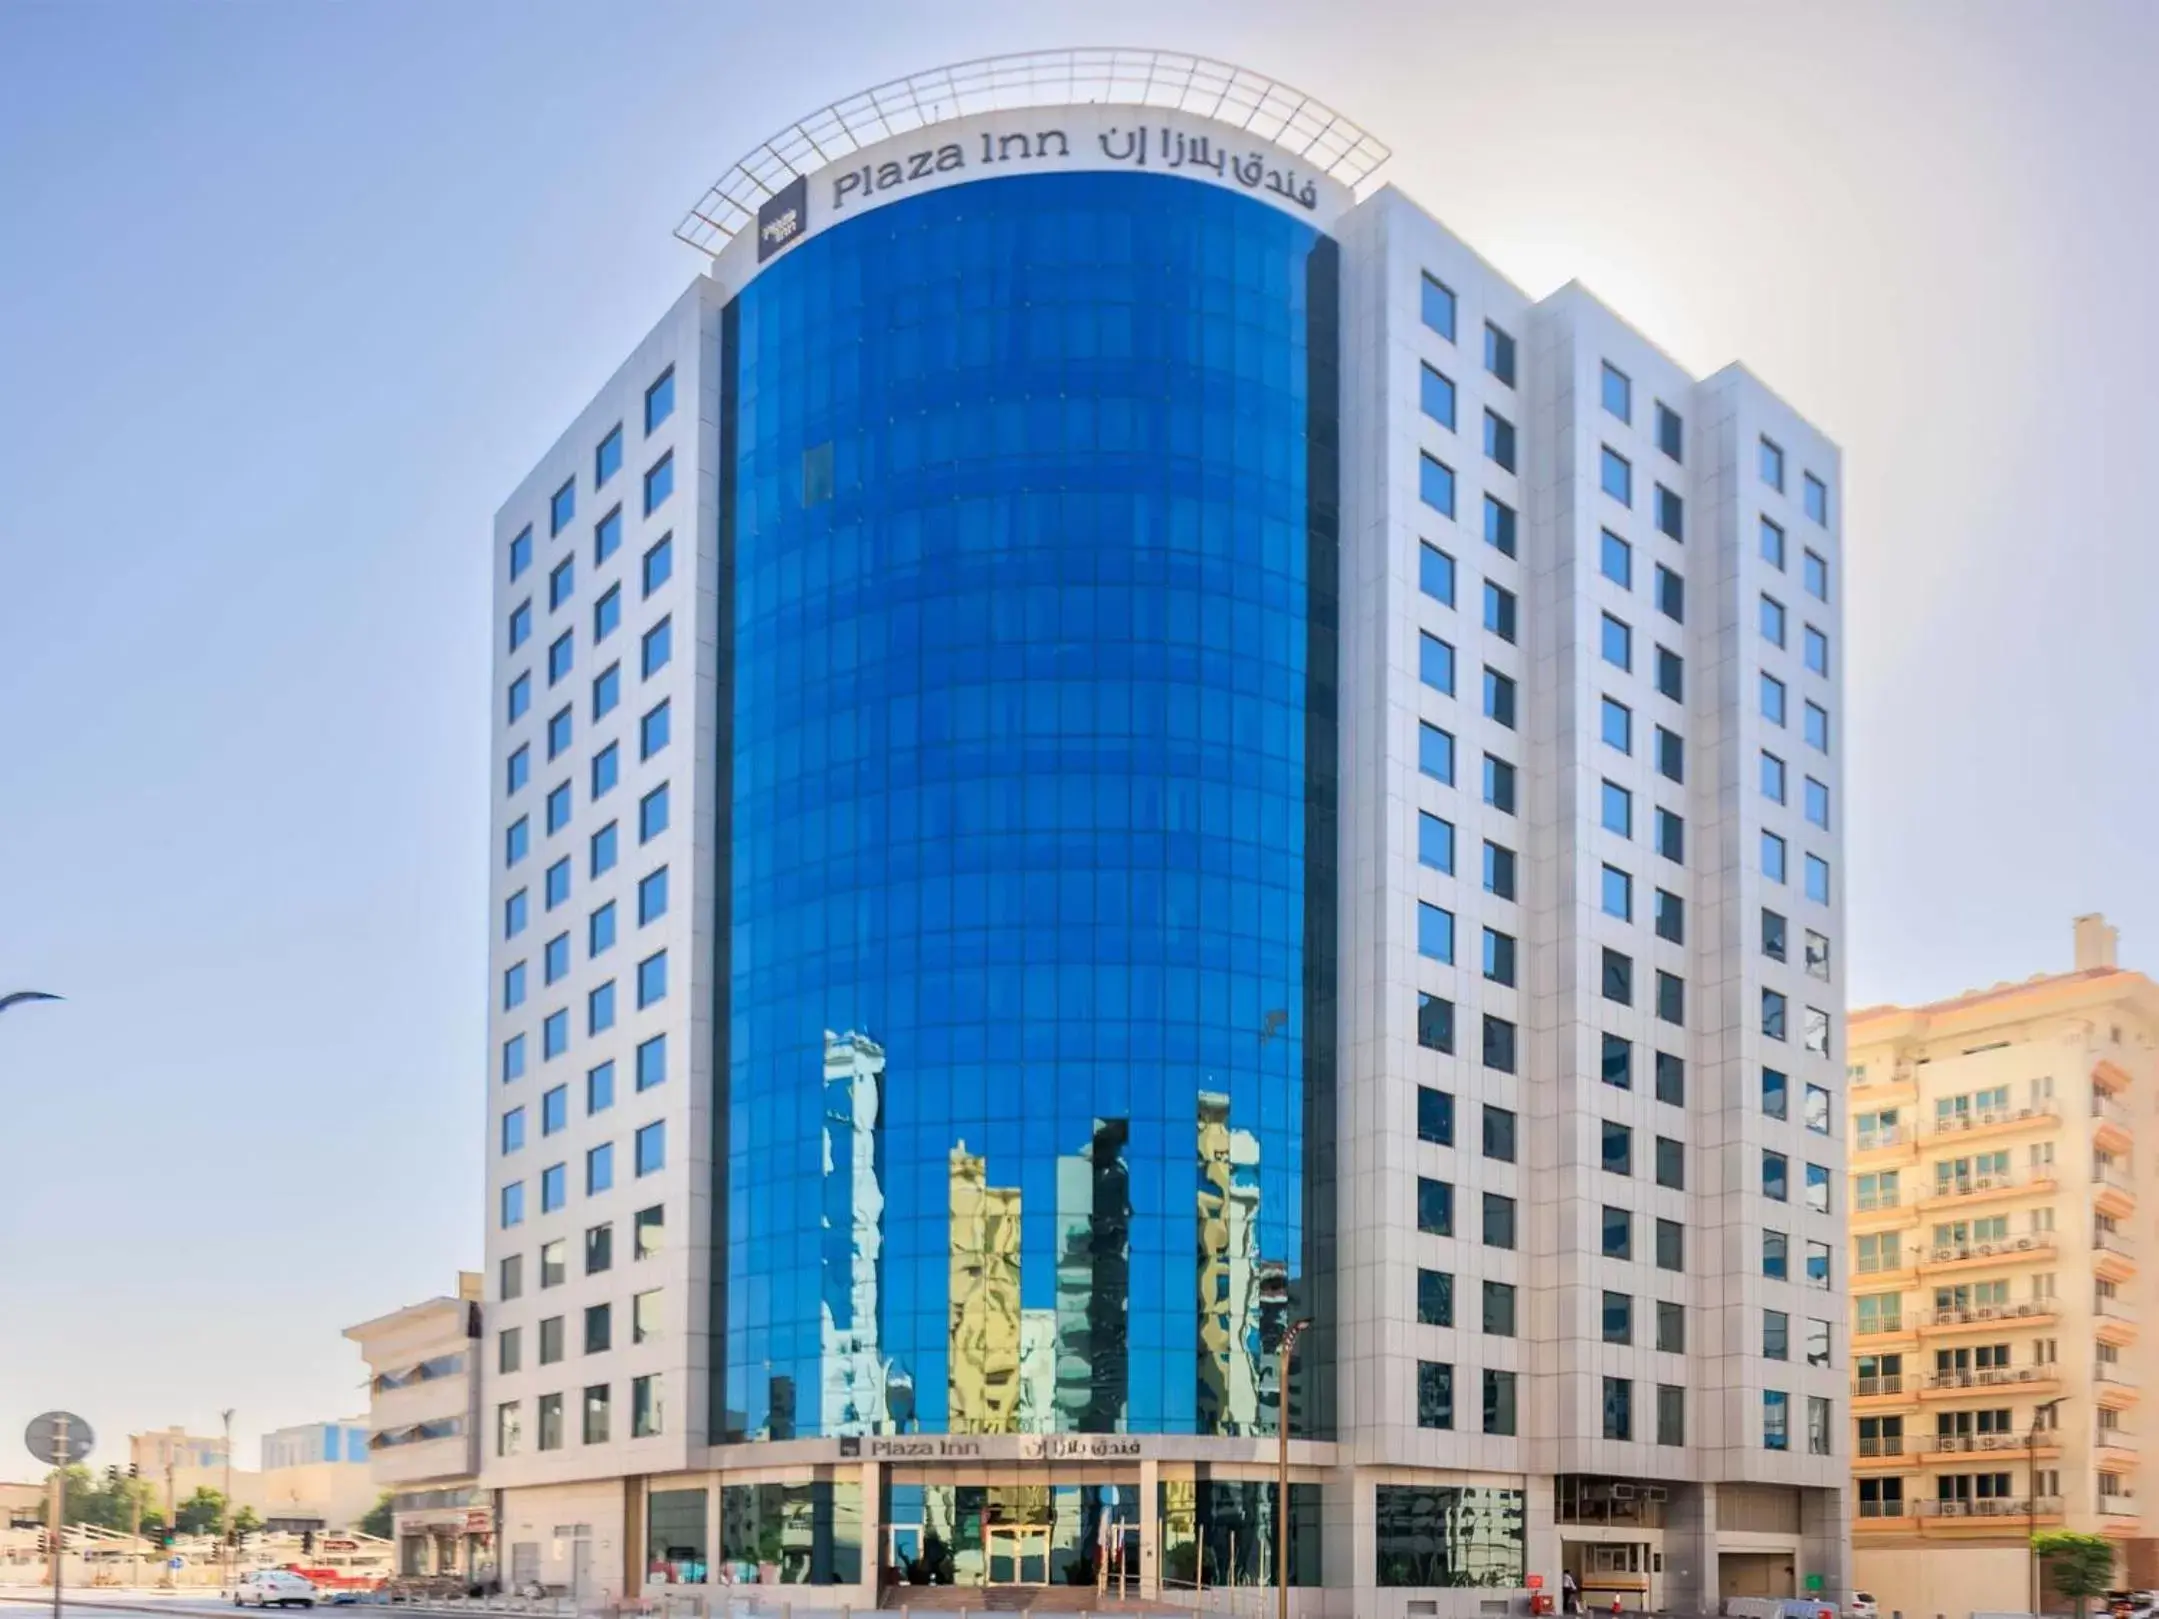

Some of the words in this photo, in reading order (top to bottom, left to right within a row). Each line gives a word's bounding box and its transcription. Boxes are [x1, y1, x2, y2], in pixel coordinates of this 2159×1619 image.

[832, 142, 966, 210] Plaza
[980, 129, 1071, 164] Inn
[1161, 127, 1226, 178] بلازا
[1231, 152, 1318, 211] فندق
[871, 1439, 934, 1456] Plaza
[940, 1439, 980, 1456] Inn
[1091, 1438, 1141, 1456] فندق
